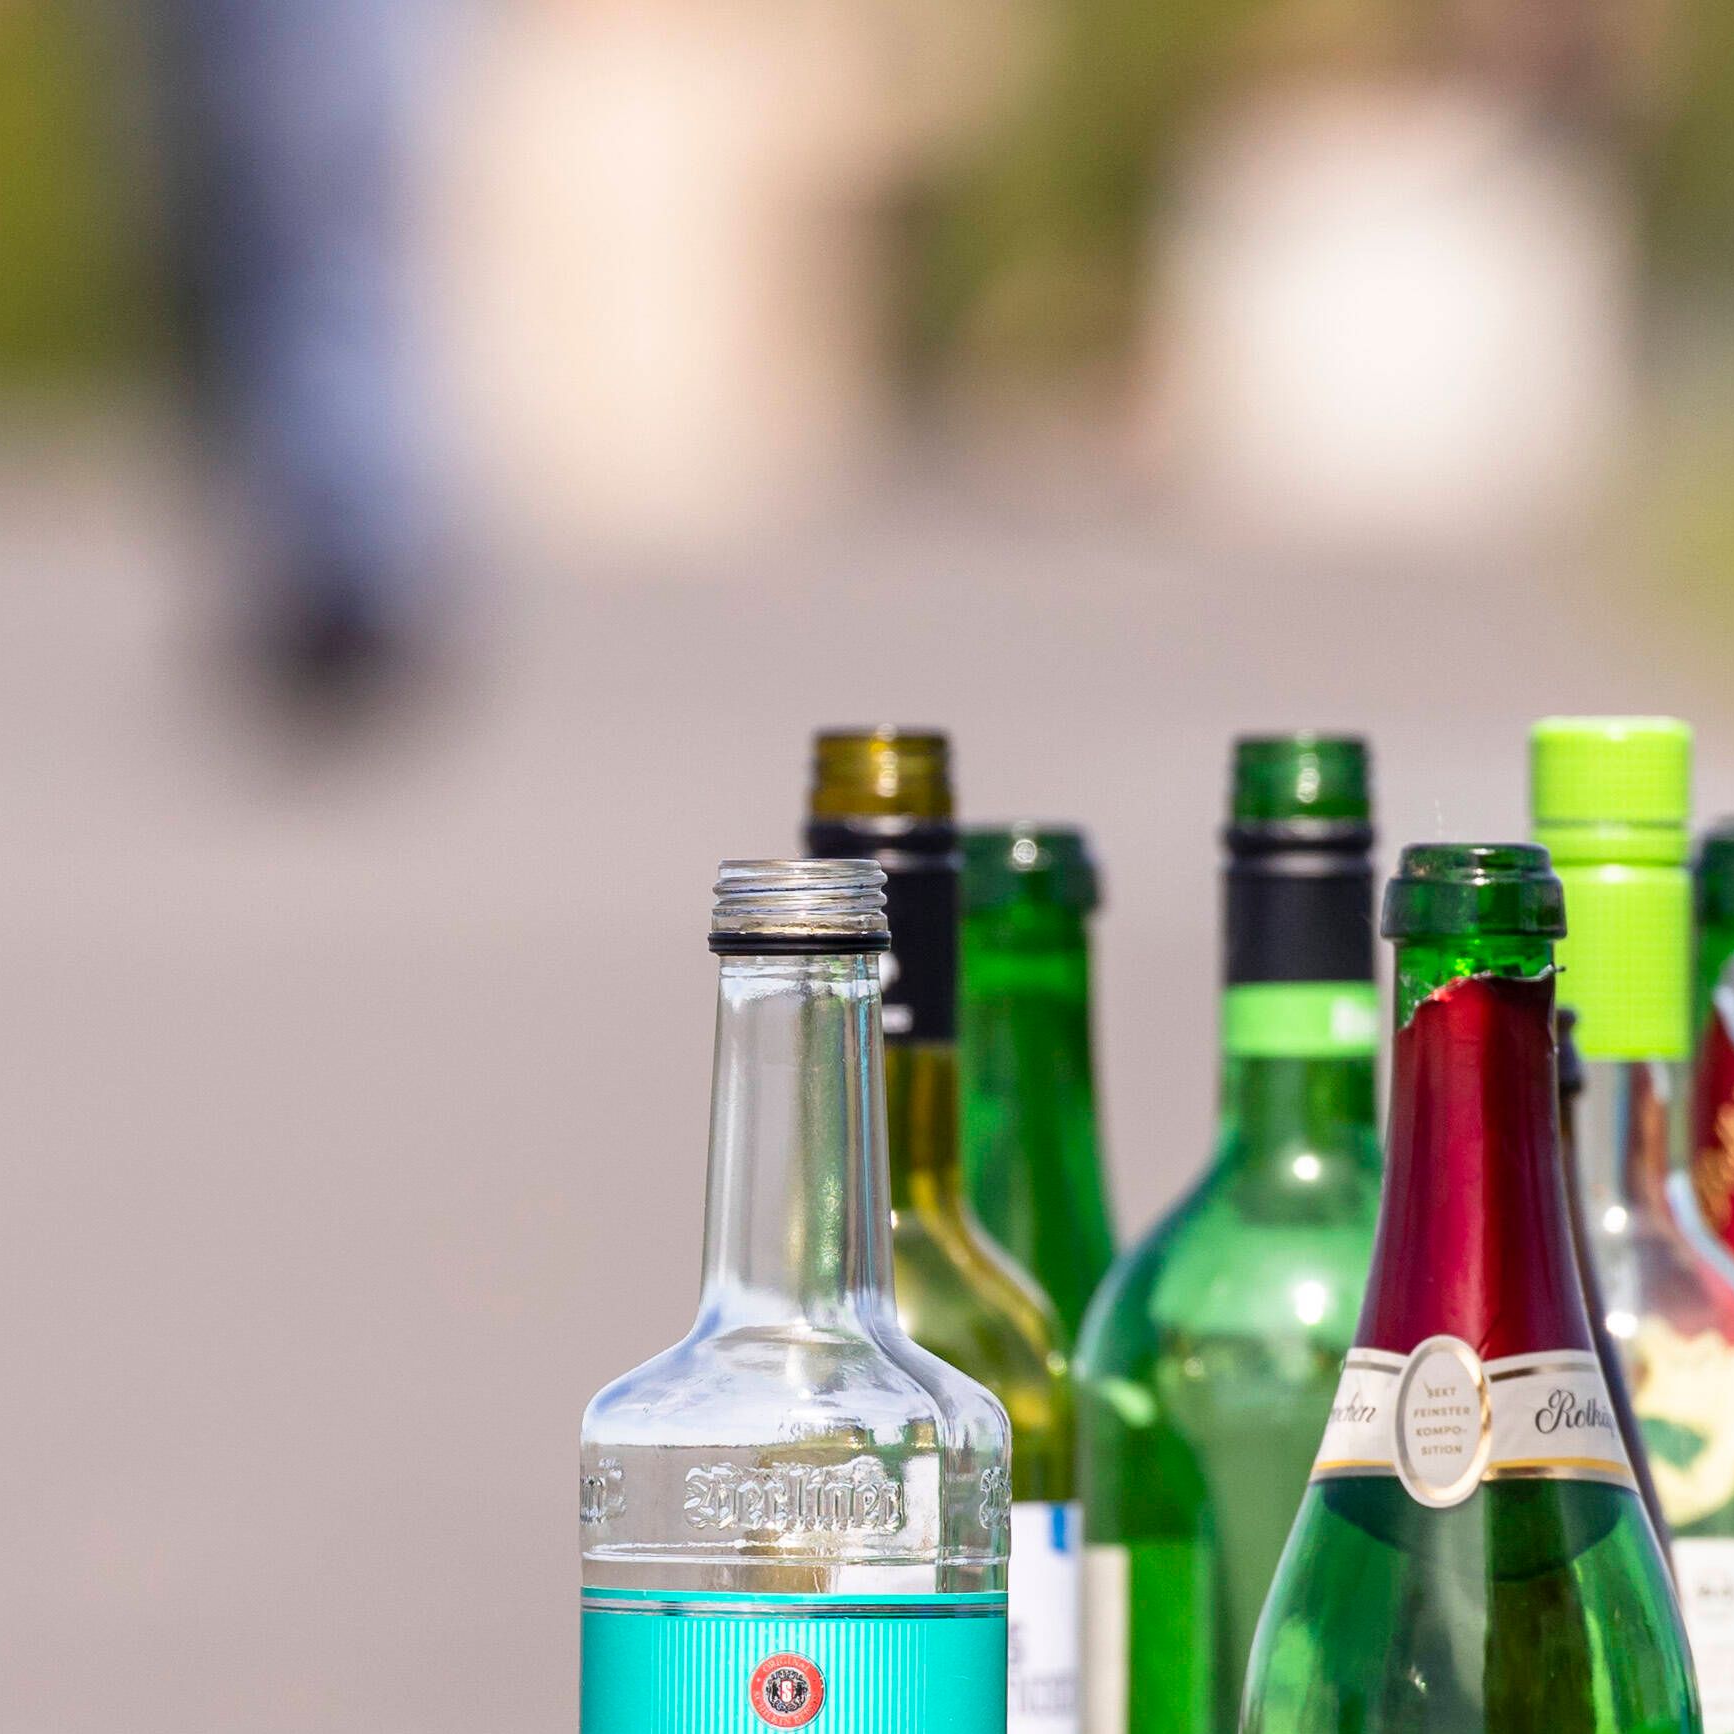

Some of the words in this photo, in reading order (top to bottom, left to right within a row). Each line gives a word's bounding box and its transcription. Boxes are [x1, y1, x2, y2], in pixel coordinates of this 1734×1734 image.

[1427, 1386, 1457, 1398] SEKT
[1413, 1406, 1471, 1419] FEINSTER
[1416, 1424, 1468, 1437] KOMPO-
[1420, 1444, 1463, 1456] SITION
